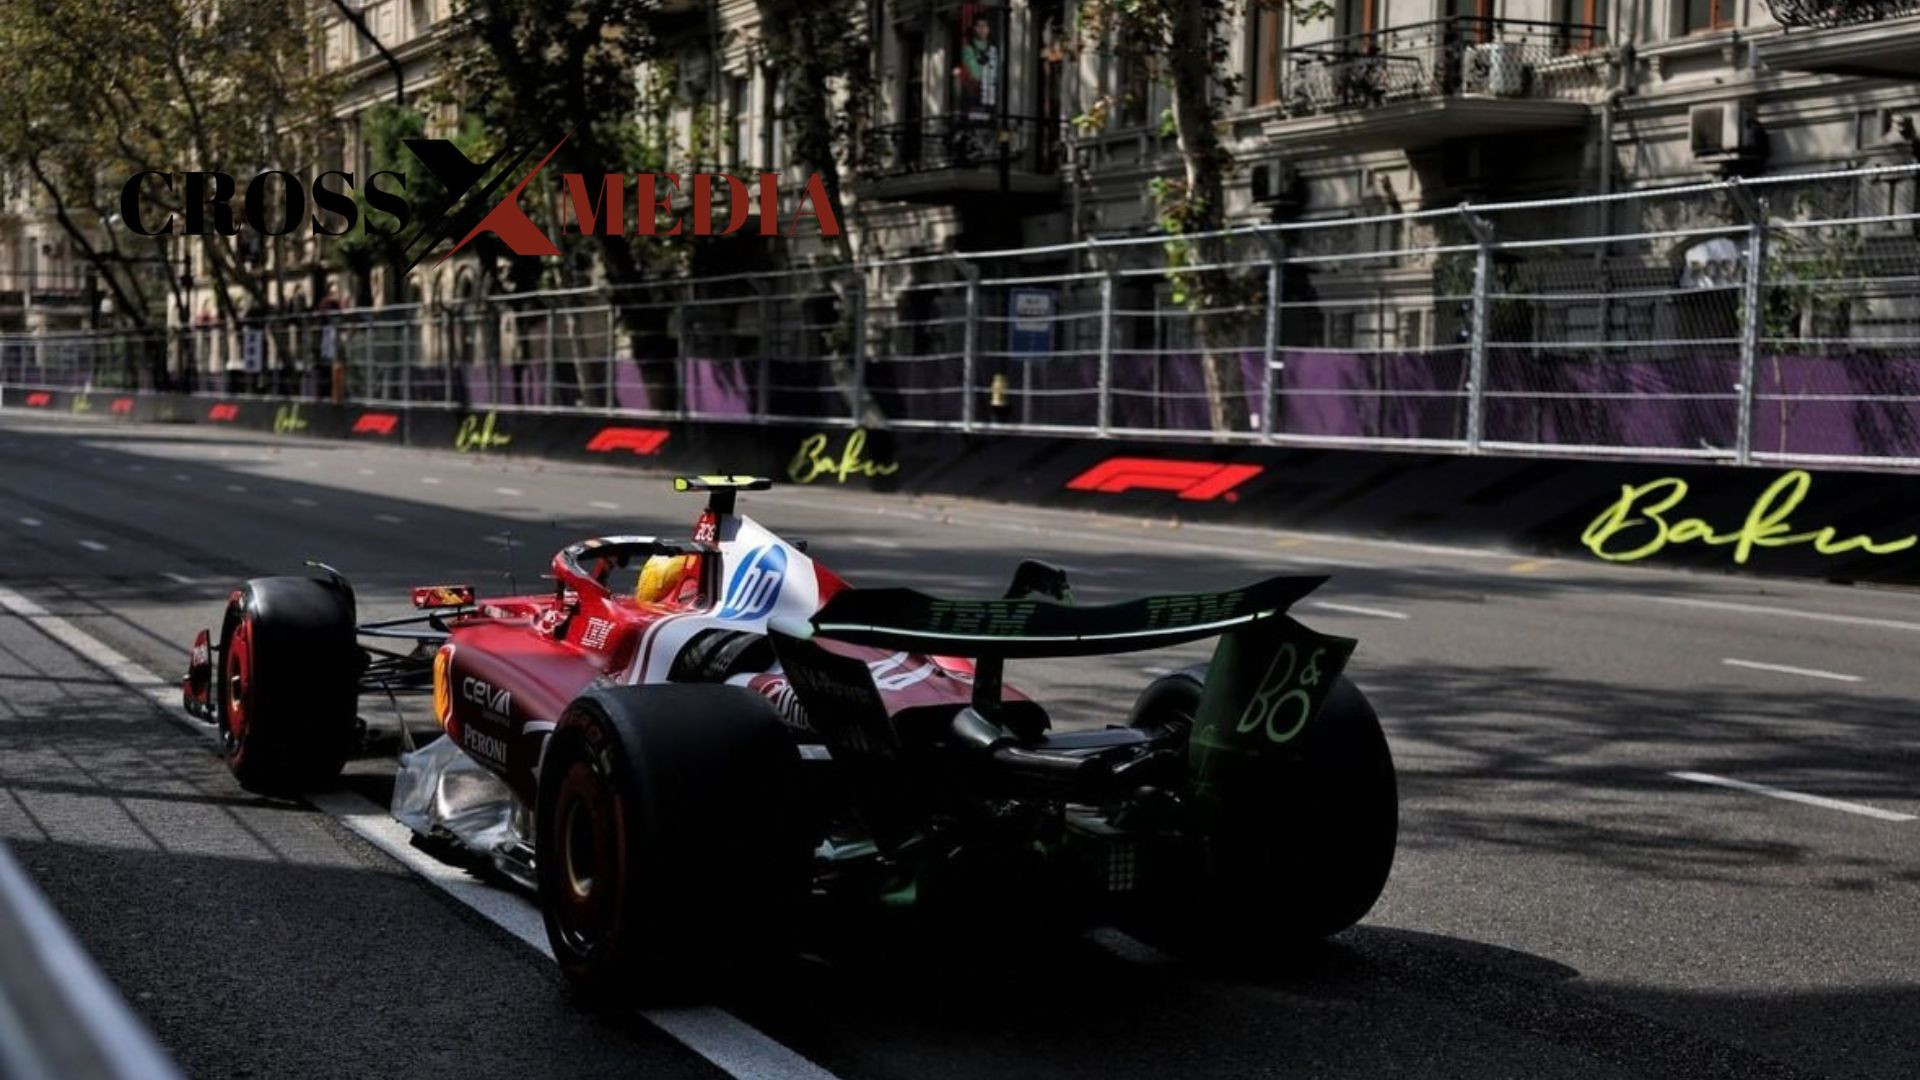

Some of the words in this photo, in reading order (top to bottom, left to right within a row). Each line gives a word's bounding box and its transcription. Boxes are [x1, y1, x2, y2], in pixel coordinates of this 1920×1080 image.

[787, 428, 899, 484] Baku
[1580, 469, 1919, 564] Baku
[927, 600, 1038, 634] IBM
[1146, 592, 1249, 628] IBM
[463, 721, 508, 766] PERONI
